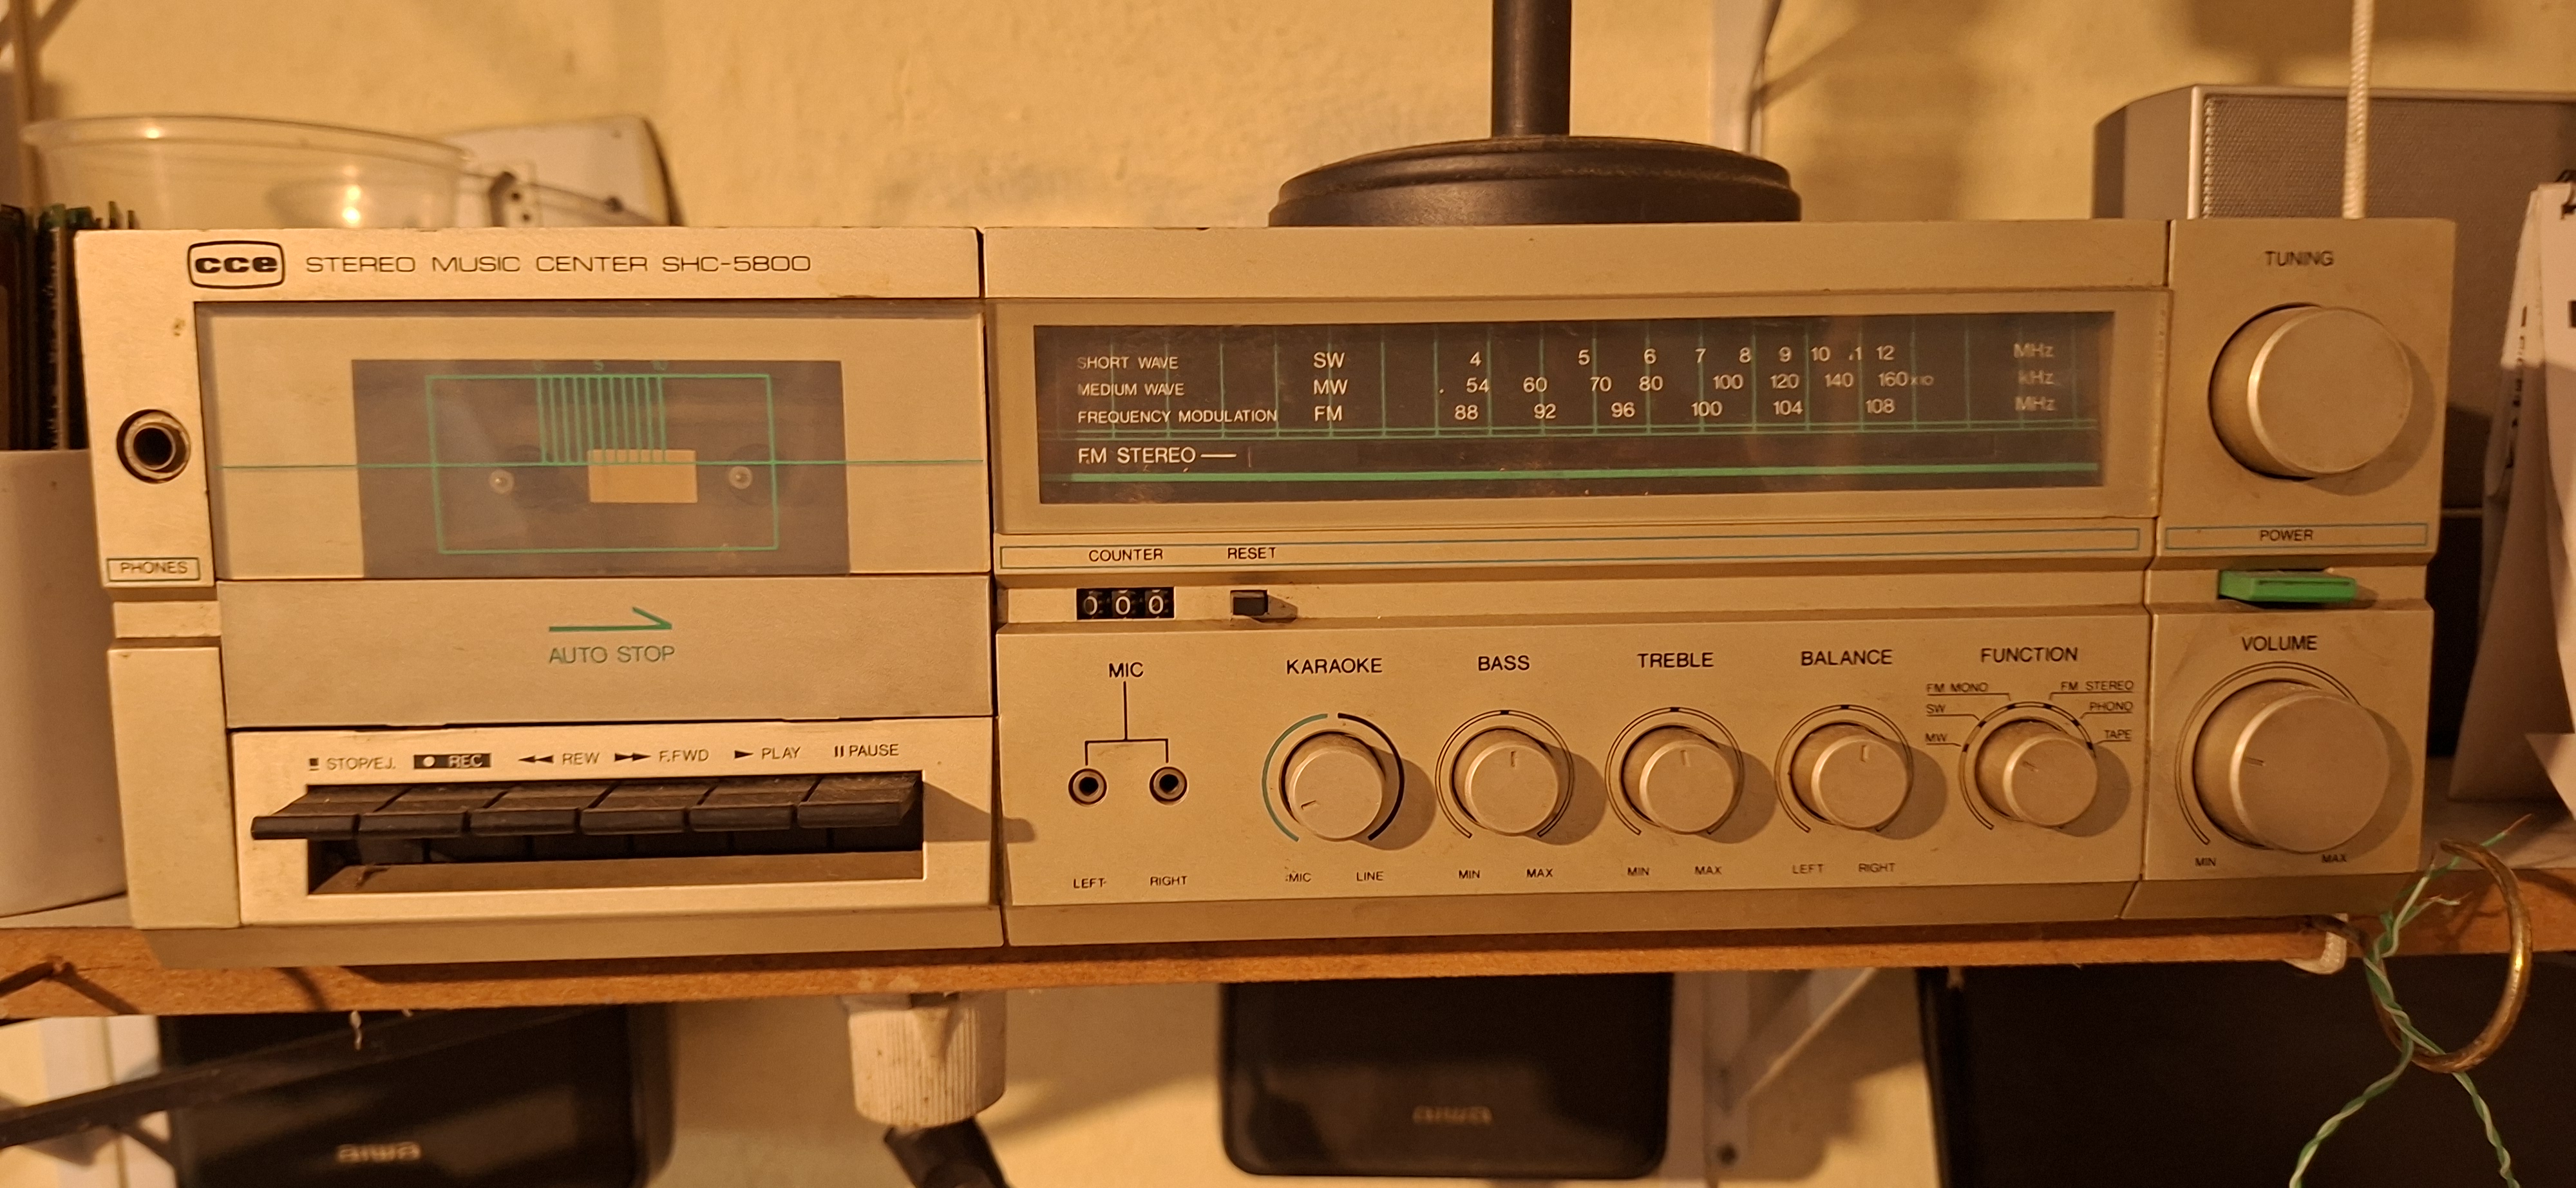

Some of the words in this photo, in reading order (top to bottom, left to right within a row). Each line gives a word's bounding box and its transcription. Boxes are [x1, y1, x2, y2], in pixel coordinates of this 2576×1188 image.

[194, 256, 278, 273] cce
[306, 256, 416, 273] STEREO
[432, 256, 521, 273] MUSIC
[536, 256, 648, 272] CENTER
[662, 255, 811, 272] SHC-5800
[2265, 250, 2334, 267] TUNING
[1076, 356, 1130, 370] SHORT
[1137, 356, 1179, 370] WAVE
[1312, 351, 1345, 369] SW
[1469, 351, 1482, 367] 4
[1578, 349, 1591, 365] 5
[1643, 348, 1658, 365] 6
[1694, 348, 1707, 363] 7
[1738, 347, 1752, 363] 8
[1779, 346, 1792, 363] 9
[1810, 345, 1832, 361] 10
[1876, 345, 1895, 361] 12
[1077, 383, 1137, 396] MEDIUM
[1144, 382, 1186, 396] WAVE
[1312, 378, 1348, 395] MW
[1466, 377, 1490, 393] 54
[1522, 376, 1548, 393] 60
[1589, 376, 1612, 392] 70
[1638, 375, 1664, 391] 80
[1712, 374, 1744, 390] 100
[1770, 373, 1800, 389] 120
[1824, 372, 1854, 388] 140
[1077, 410, 1172, 424] FREQUENCY
[1178, 409, 1278, 423] MODULATION
[1314, 405, 1343, 422] FM
[1454, 404, 1479, 421] 88
[1533, 403, 1557, 420] 92
[1611, 401, 1636, 418] 96
[1690, 400, 1723, 417] 100
[1773, 399, 1804, 416] 104
[1865, 398, 1896, 414] 108
[1078, 447, 1108, 464] FM
[1116, 446, 1197, 464] STEREO
[2259, 530, 2313, 542] POWER
[1088, 548, 1164, 562] COUNTER
[1227, 547, 1276, 560] RESET
[120, 561, 188, 575] PHONES
[2240, 635, 2318, 651] VOLUME
[549, 646, 608, 664] AUTO
[617, 645, 676, 662] STOP
[1636, 651, 1715, 669] TREBLE
[1800, 649, 1893, 666] BALANCE
[1980, 646, 2078, 662] FUNCTION
[1108, 662, 1144, 678] MIC
[1286, 657, 1383, 675] KARAOKE
[1477, 655, 1531, 671] BASS
[1926, 683, 1945, 693] FM
[1950, 682, 1989, 693] MONO
[2060, 680, 2079, 691] FM
[2085, 680, 2134, 691] STEREO
[1926, 704, 1946, 714] SW
[2089, 701, 2134, 711] PHONO
[1925, 733, 1948, 743] MW
[2104, 729, 2133, 740] TAPE
[658, 748, 710, 763] F.FWD
[761, 746, 801, 760] PLAY
[848, 743, 900, 757] PAUSE
[327, 756, 397, 771] STOP/EJ.
[448, 753, 484, 768] REC
[562, 751, 600, 765] REW
[2195, 857, 2217, 867] MIN
[2322, 854, 2347, 863] MAX
[1457, 869, 1481, 879] MIN
[1526, 868, 1554, 878] MAX
[1627, 867, 1650, 877] MIN
[1694, 865, 1723, 876] MAX
[1792, 863, 1824, 874] LEFT
[1857, 861, 1896, 873] RIGHT
[1072, 877, 1104, 889] LEFT
[1150, 875, 1188, 886] RIGHT
[1289, 872, 1312, 883] MIC
[1356, 870, 1384, 882] LINE
